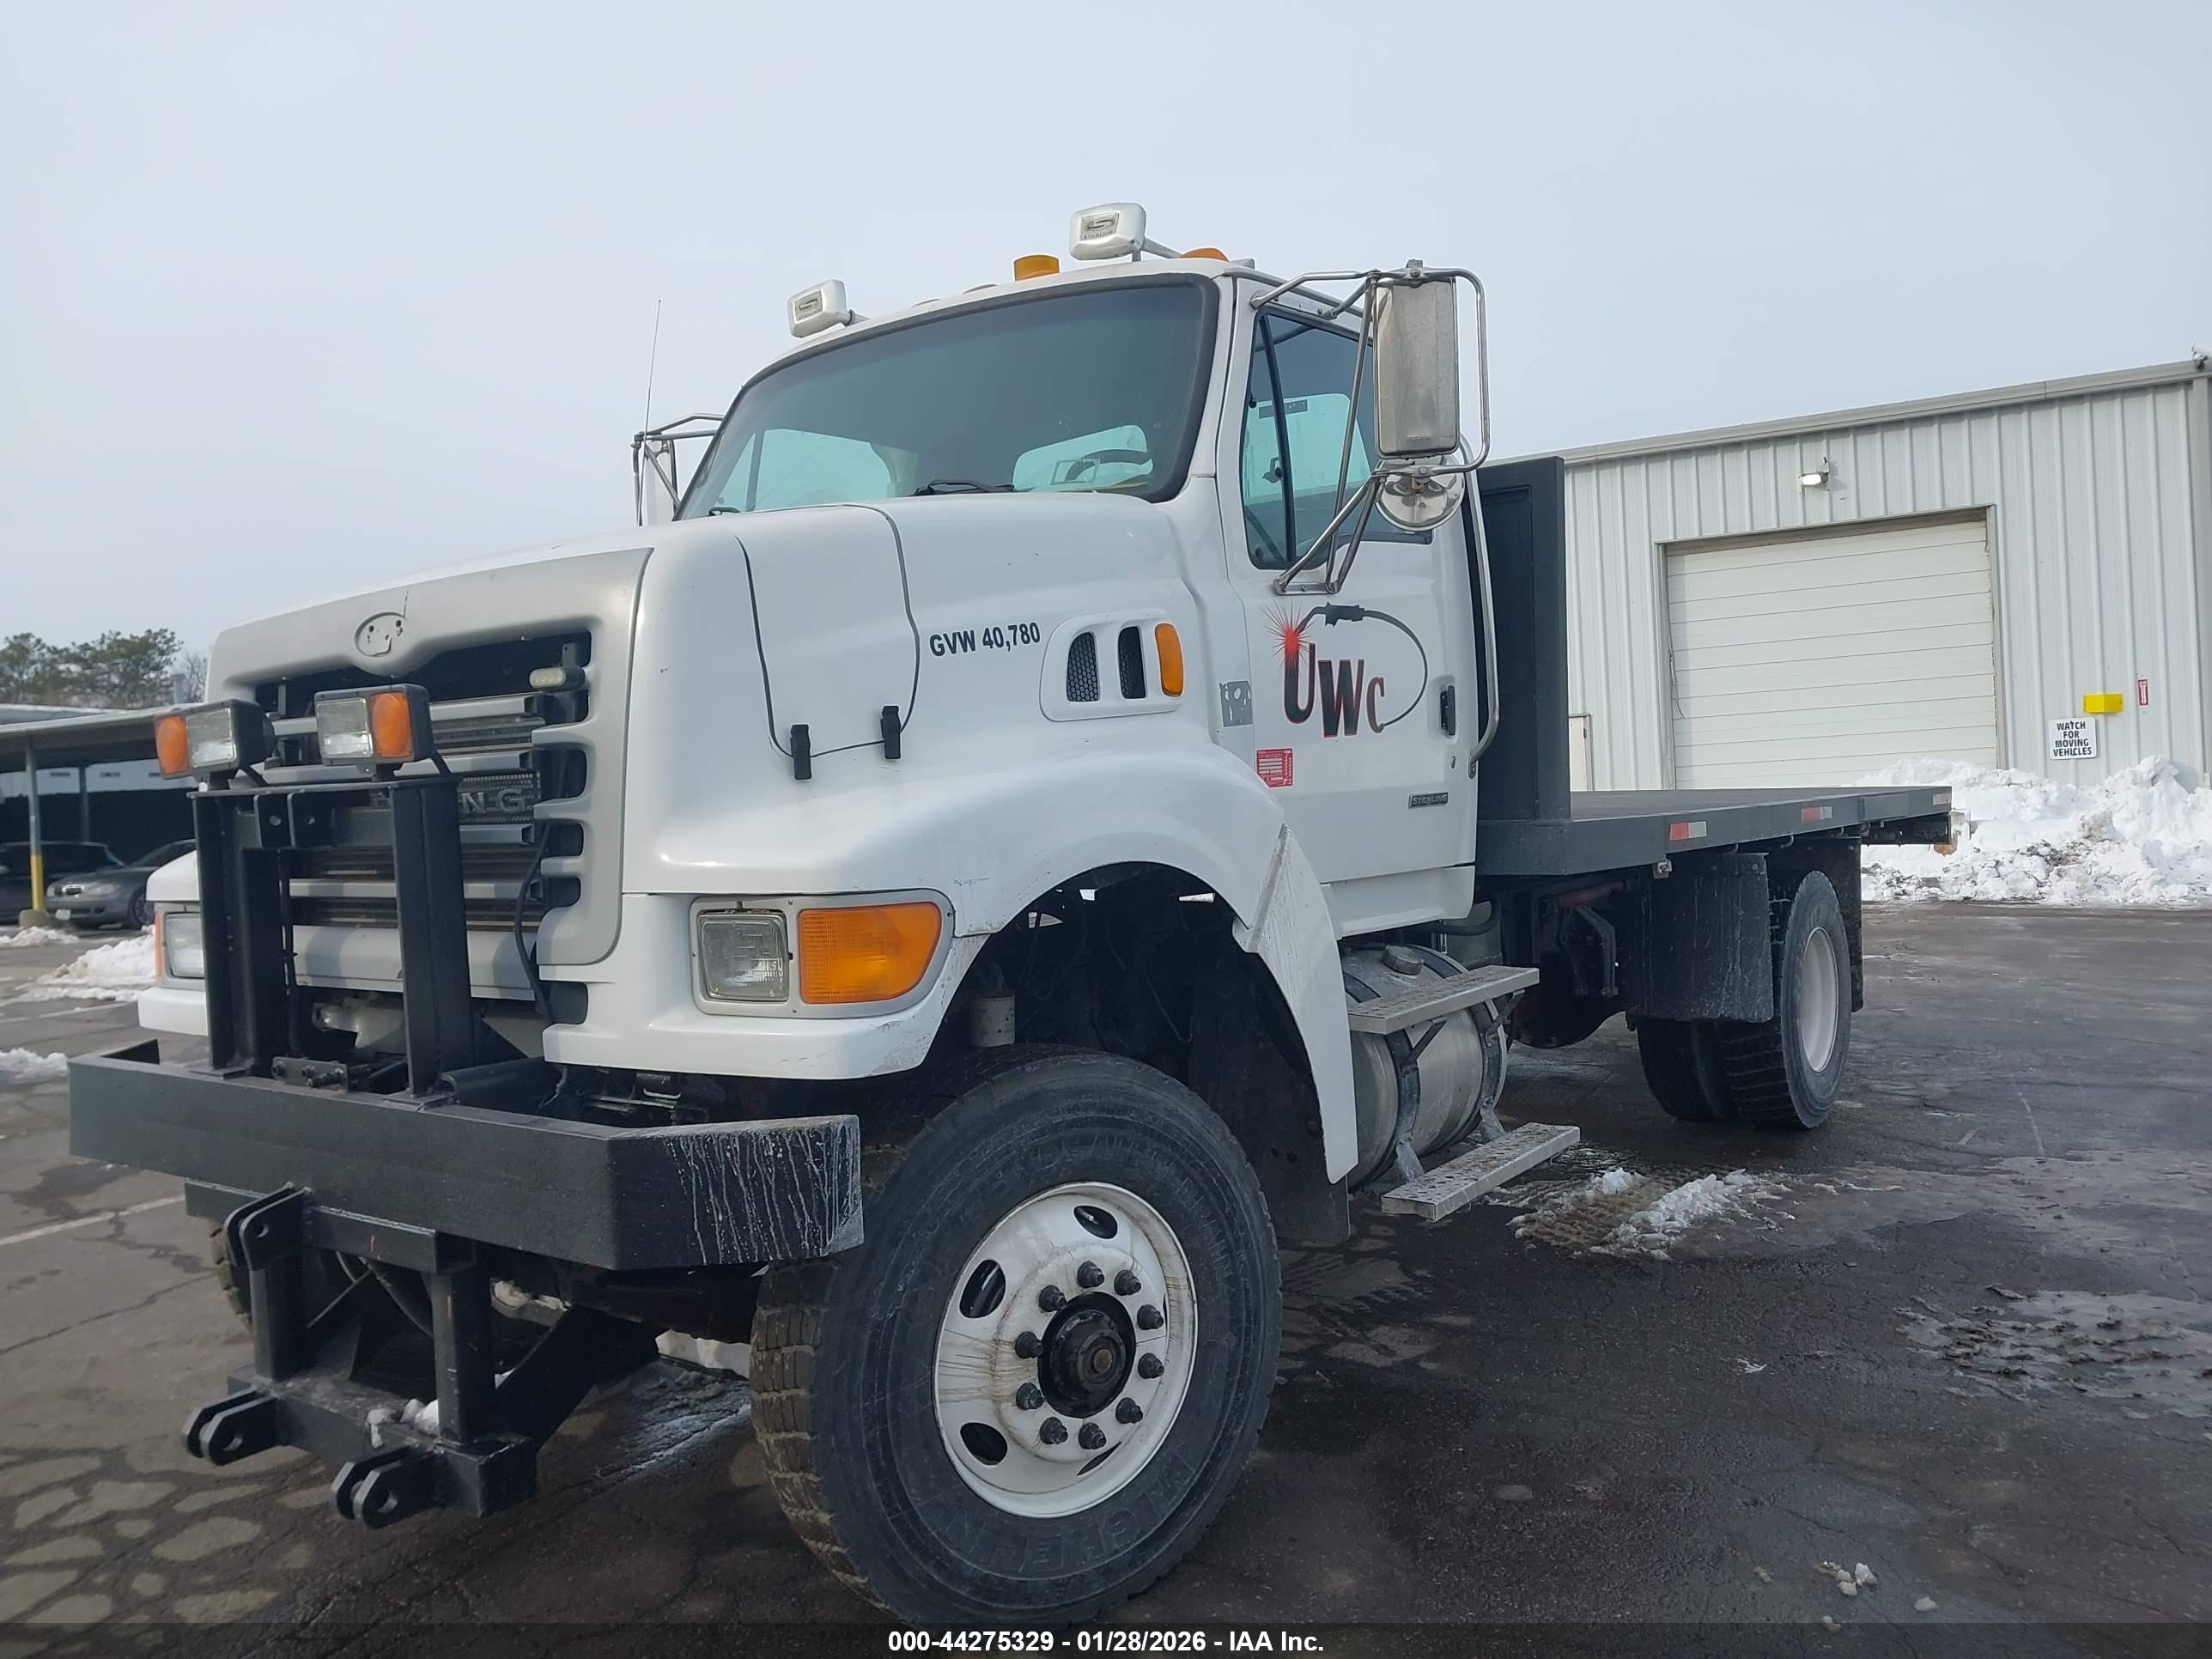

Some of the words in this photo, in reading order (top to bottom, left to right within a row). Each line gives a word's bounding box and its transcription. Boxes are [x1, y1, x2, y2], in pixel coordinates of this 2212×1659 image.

[929, 629, 976, 657] GVW
[982, 622, 1041, 652] 40,780
[2056, 721, 2086, 731] WATCH
[2063, 731, 2080, 739] FOR
[2055, 738, 2089, 748] MOVING
[2053, 747, 2093, 757] VEHICLES
[1413, 793, 1448, 805] STERLING
